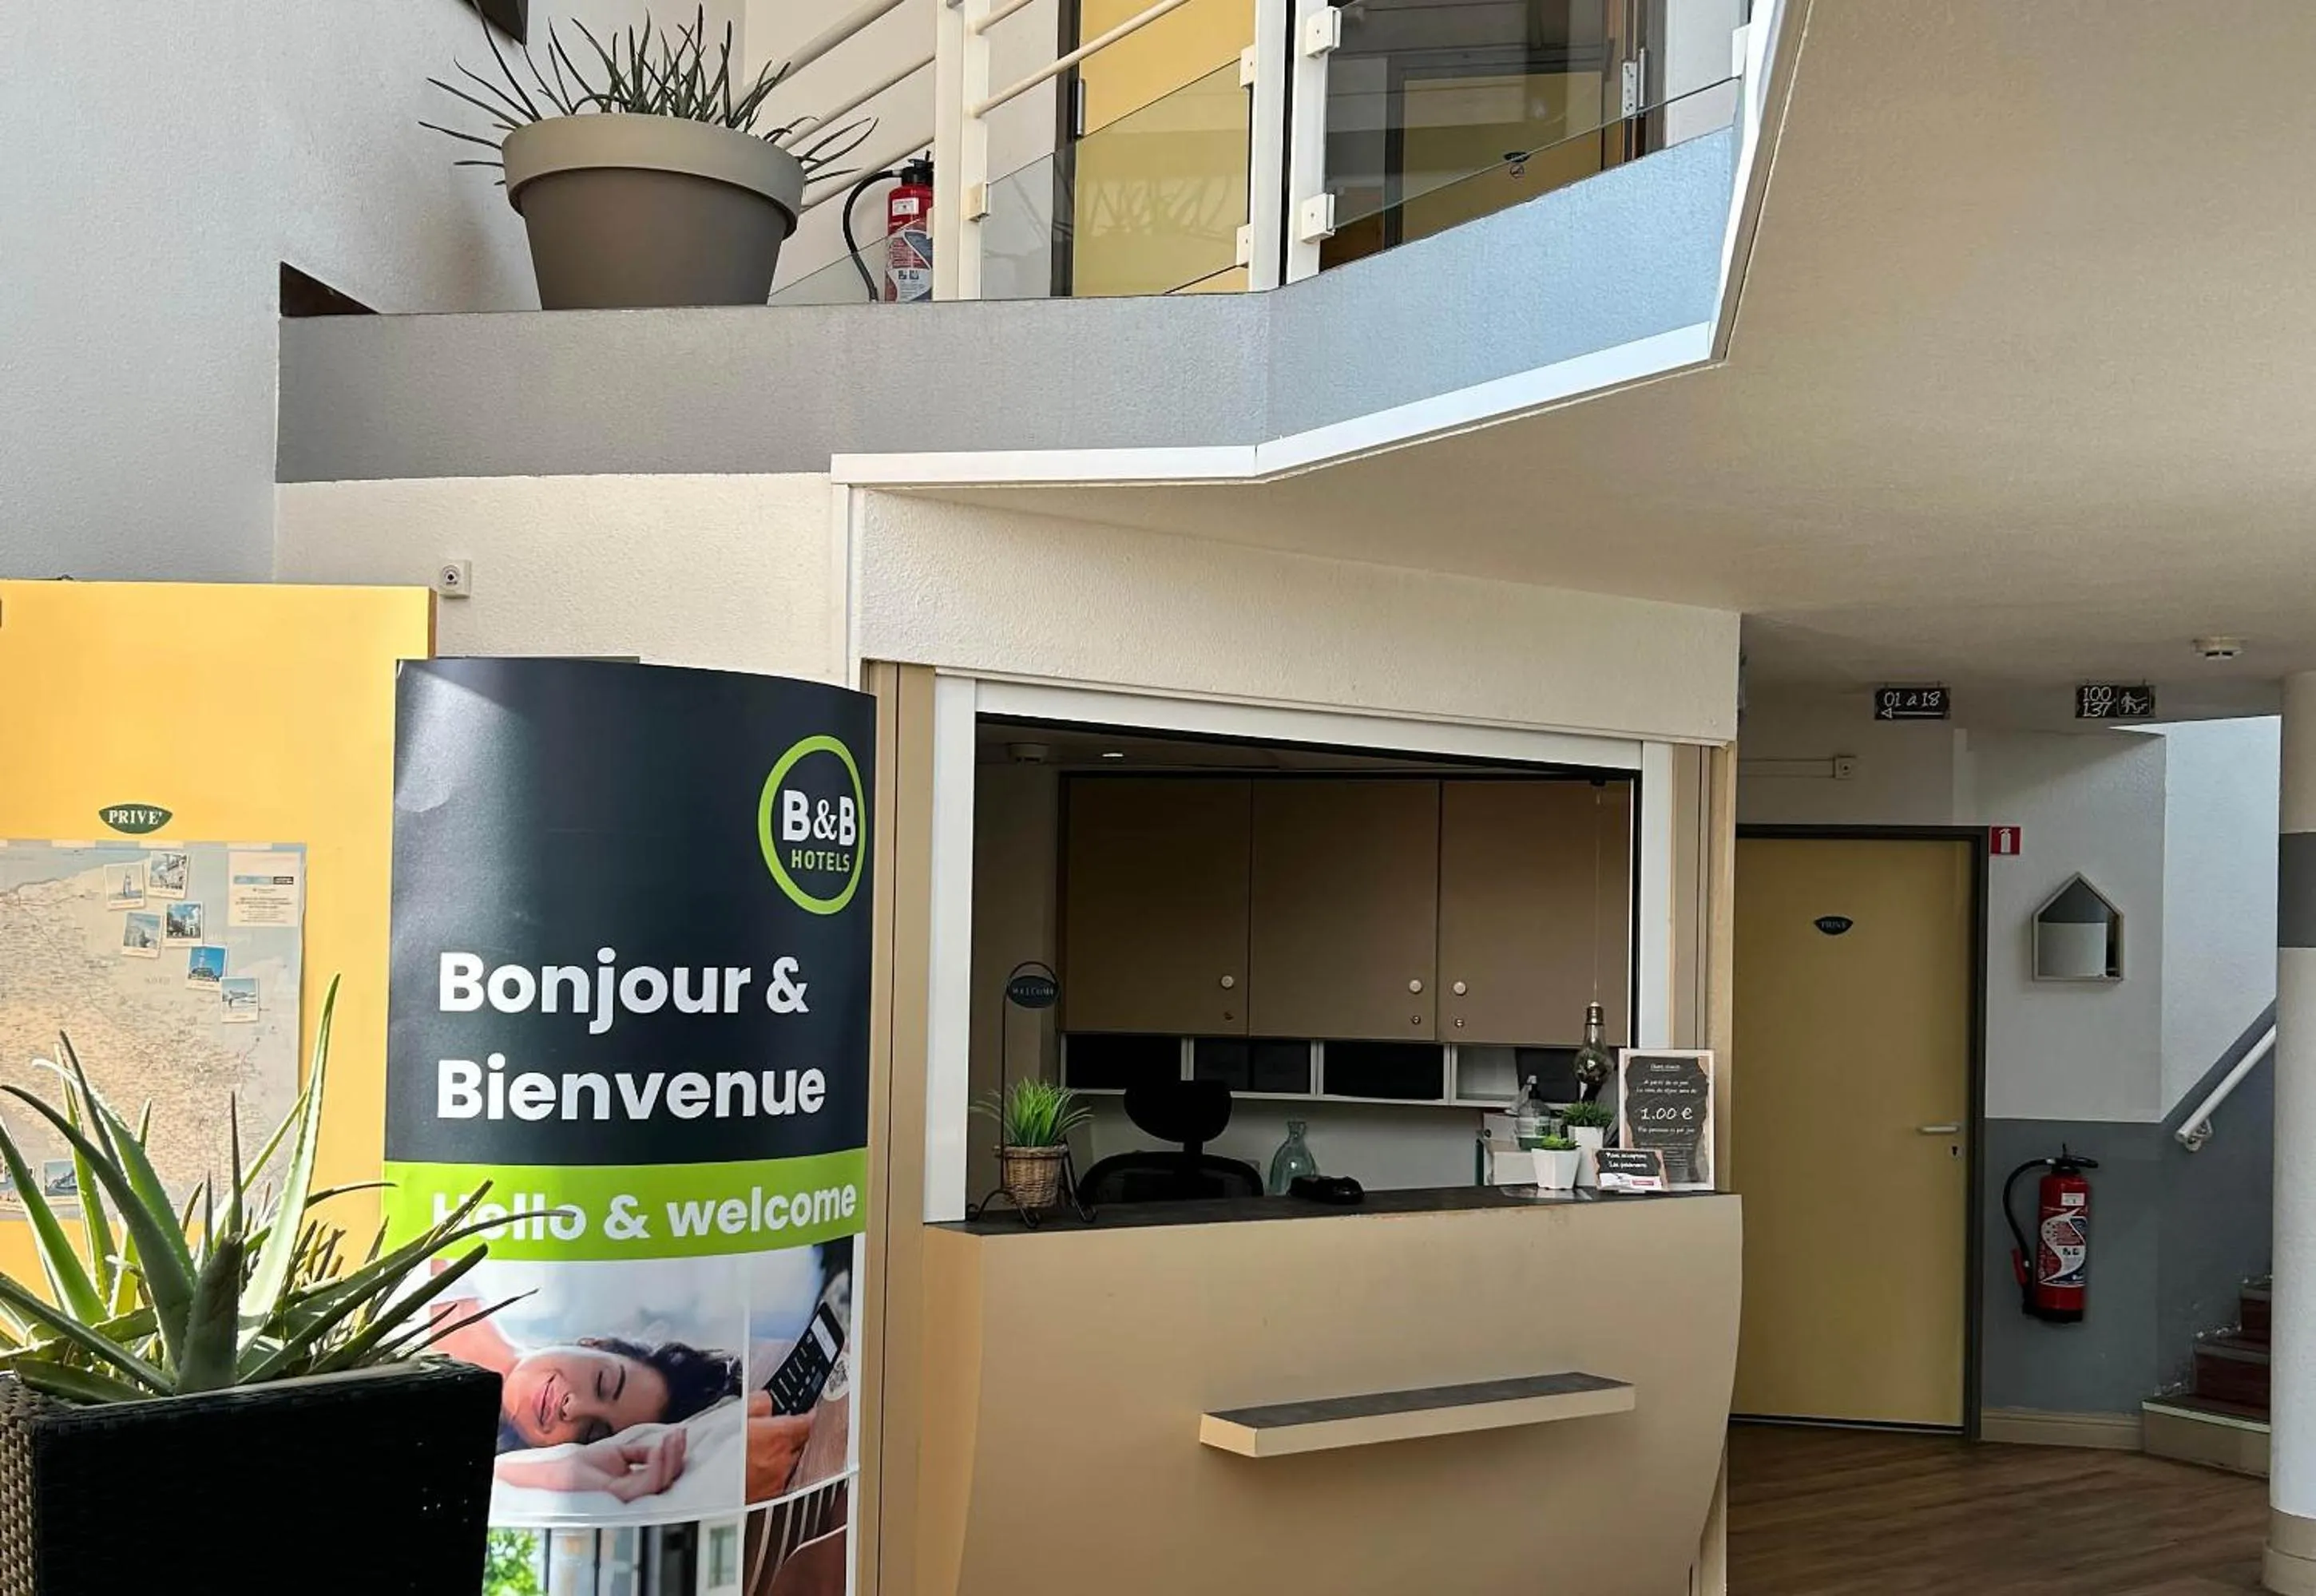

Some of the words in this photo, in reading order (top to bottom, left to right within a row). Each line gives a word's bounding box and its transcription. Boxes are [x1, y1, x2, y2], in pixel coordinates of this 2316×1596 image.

[1884, 691, 1901, 707] 01
[1921, 691, 1941, 707] 18
[2083, 687, 2112, 702] 100
[2083, 701, 2114, 717] 137
[783, 789, 856, 846] B&B
[791, 849, 851, 872] HOTELS
[438, 946, 752, 1036] Bonjour
[764, 956, 810, 1014] &
[436, 1052, 826, 1121] Bienvenue
[1641, 1107, 1677, 1120] 1.00
[1681, 1107, 1694, 1120] €
[432, 1192, 587, 1242] Hello
[603, 1194, 651, 1240] &
[666, 1182, 857, 1238] welcome
